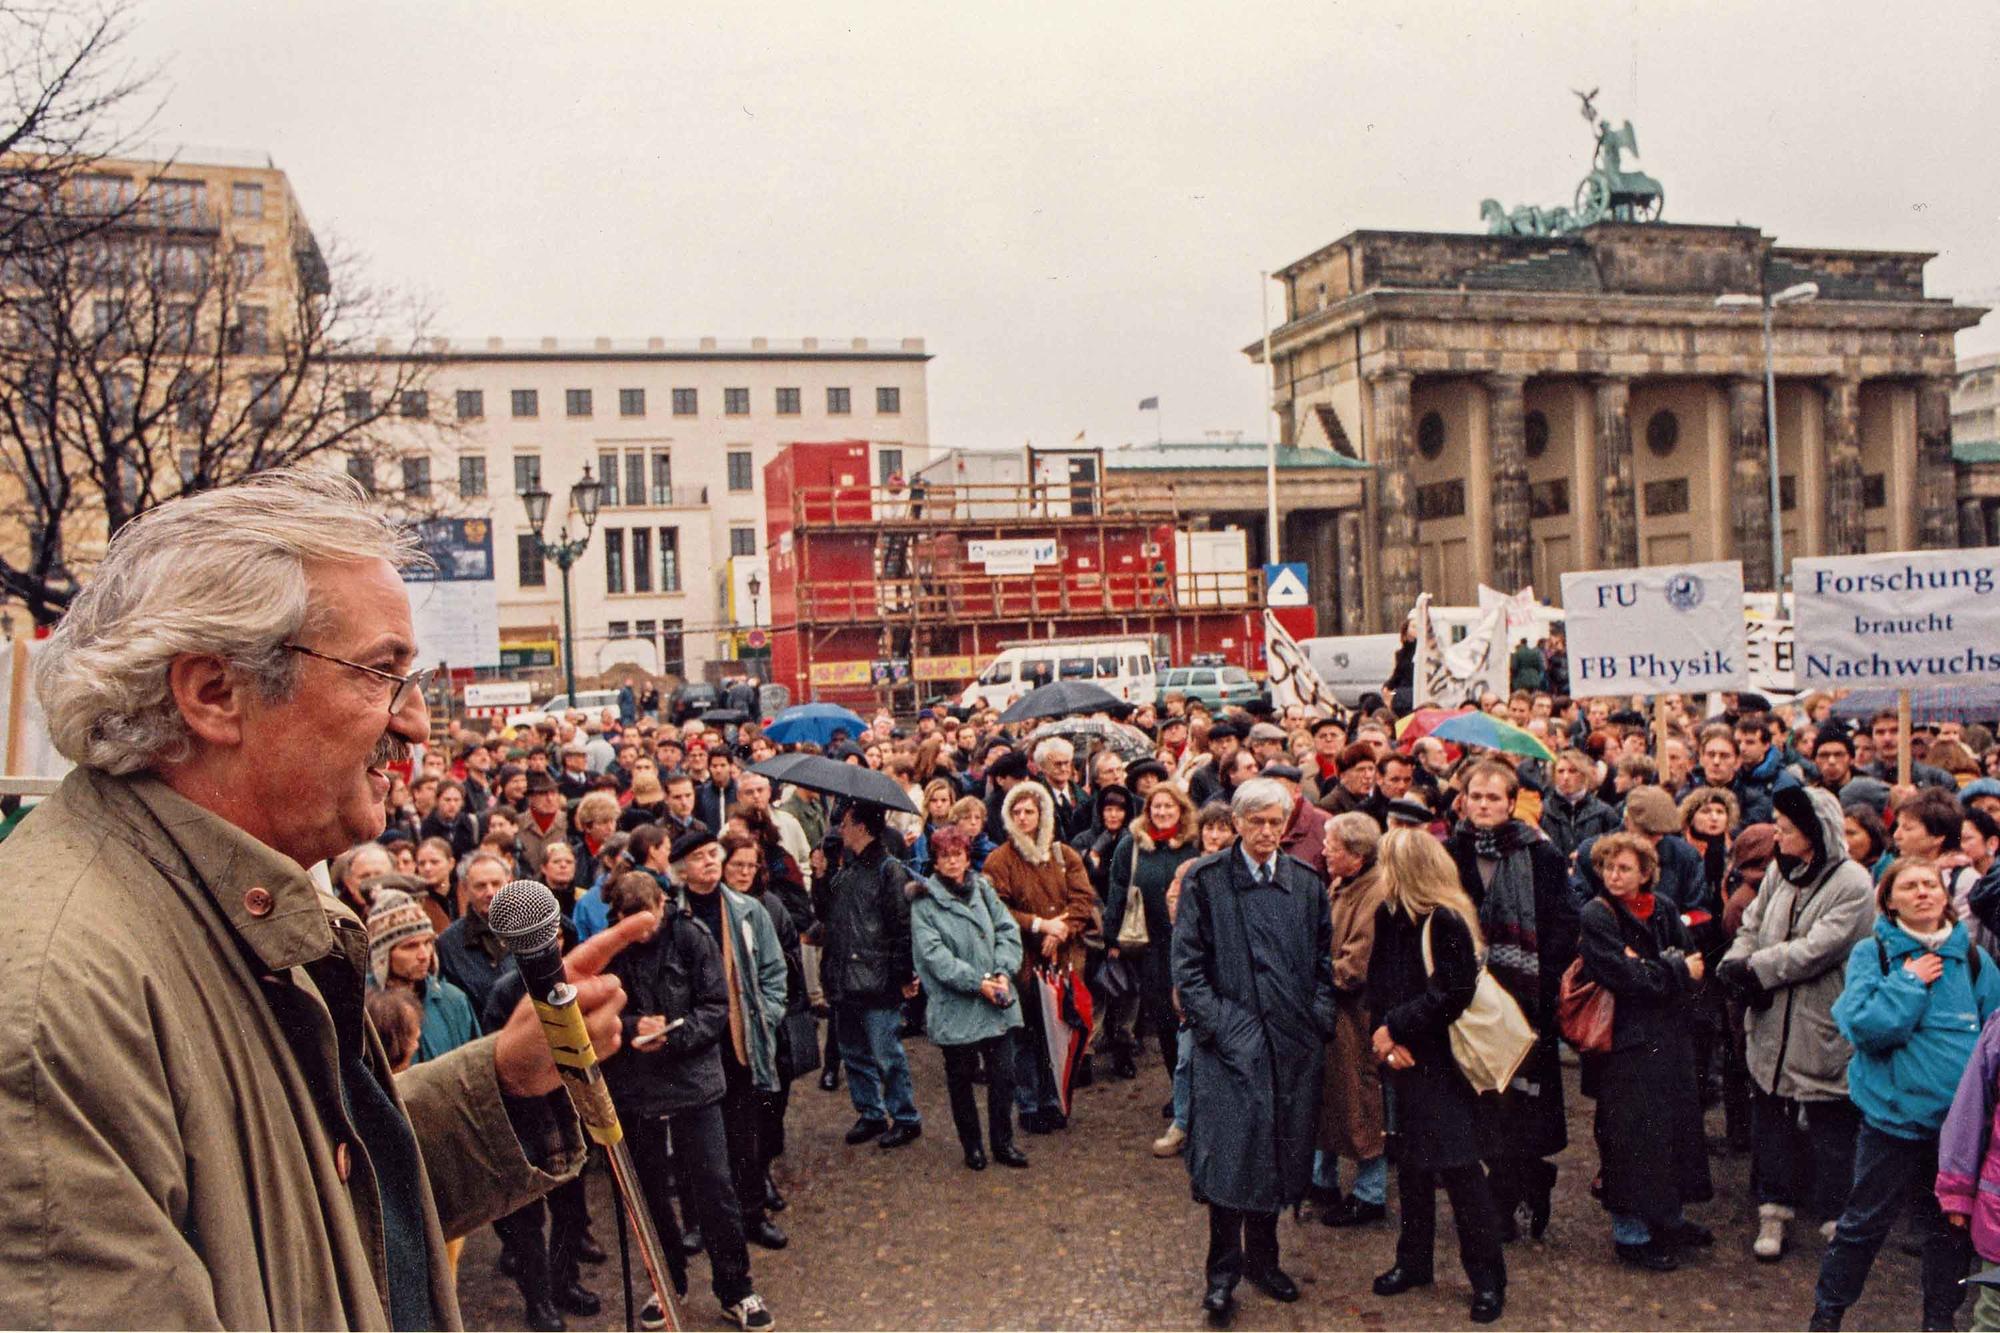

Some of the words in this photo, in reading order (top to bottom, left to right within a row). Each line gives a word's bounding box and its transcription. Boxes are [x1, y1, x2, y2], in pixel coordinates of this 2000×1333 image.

[1815, 565, 1995, 595] Forschung
[1597, 584, 1637, 608] FU
[1853, 612, 1954, 635] braucht
[1580, 655, 1618, 679] FB
[1629, 650, 1734, 682] Physik
[1805, 647, 2000, 679] Nachwuchs
